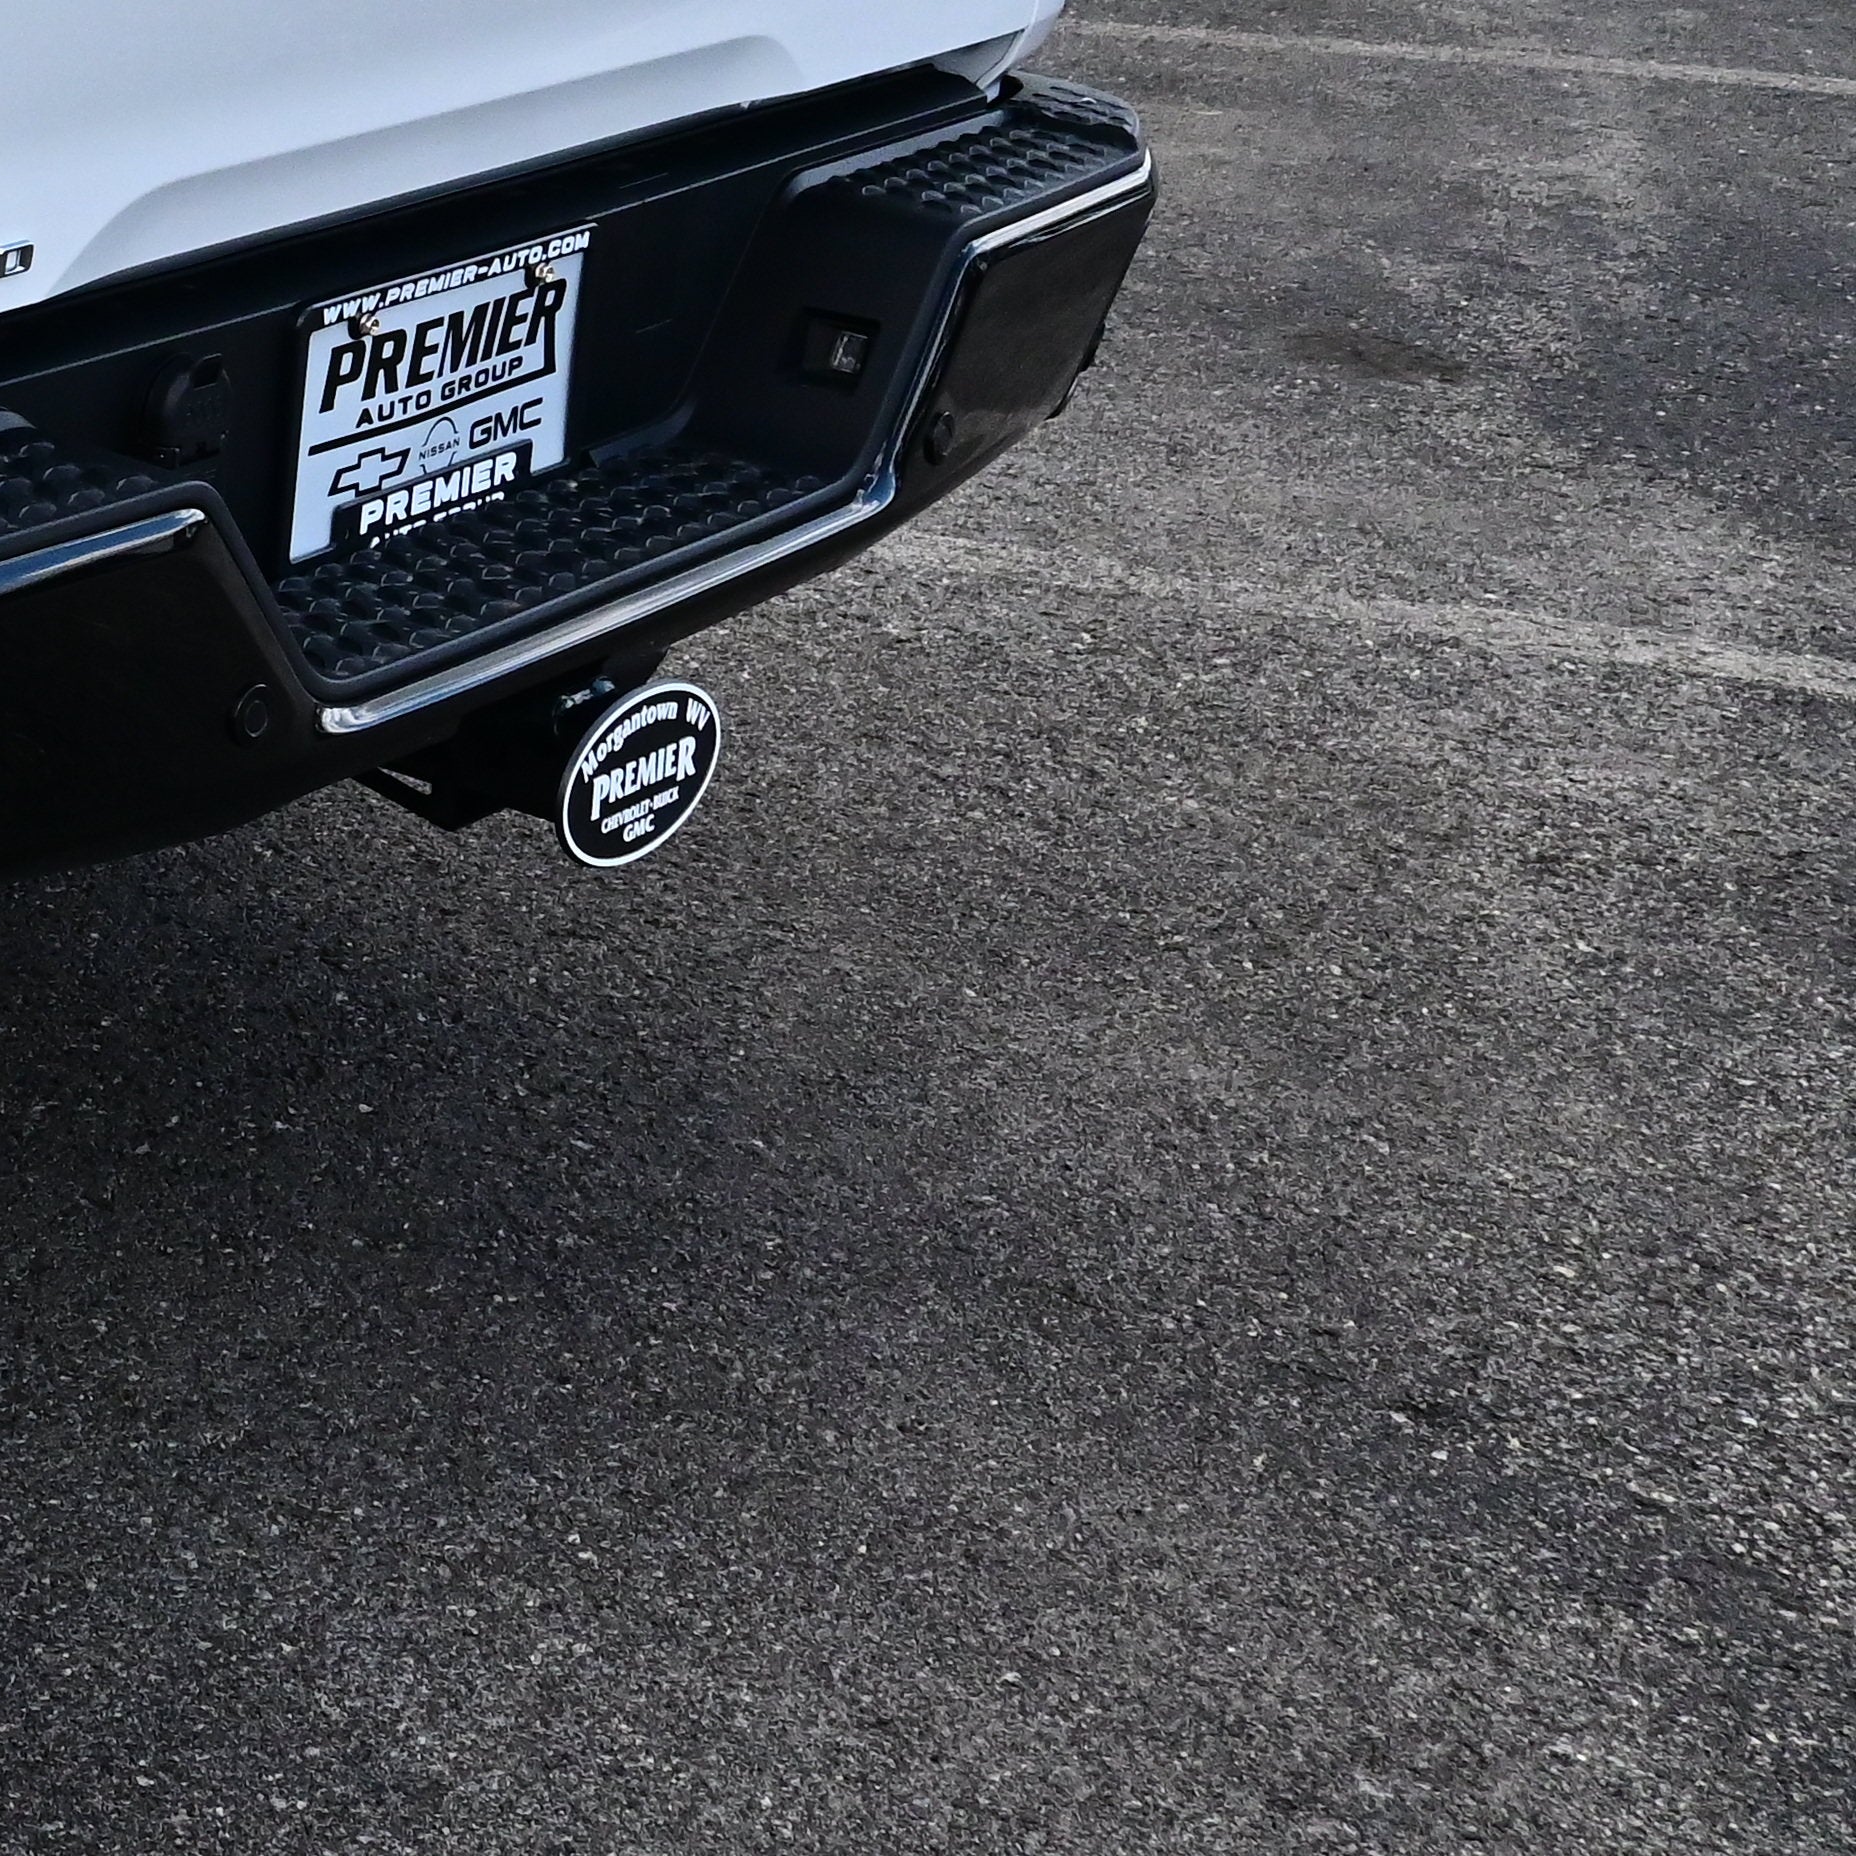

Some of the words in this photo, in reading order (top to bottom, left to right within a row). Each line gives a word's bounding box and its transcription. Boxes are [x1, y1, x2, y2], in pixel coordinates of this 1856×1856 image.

[323, 231, 590, 326] WWW.PREMIER-AUTO.COM
[319, 278, 567, 414] PREMIER
[356, 394, 432, 429] AUTO
[440, 356, 524, 402] GROUP
[418, 437, 461, 461] NISSAN
[469, 397, 544, 450] GMC
[359, 451, 517, 535] PREMIER
[580, 702, 679, 784] Morgantown
[686, 698, 711, 731] WV
[590, 736, 696, 821] PREMIER
[623, 813, 655, 842] GMC
